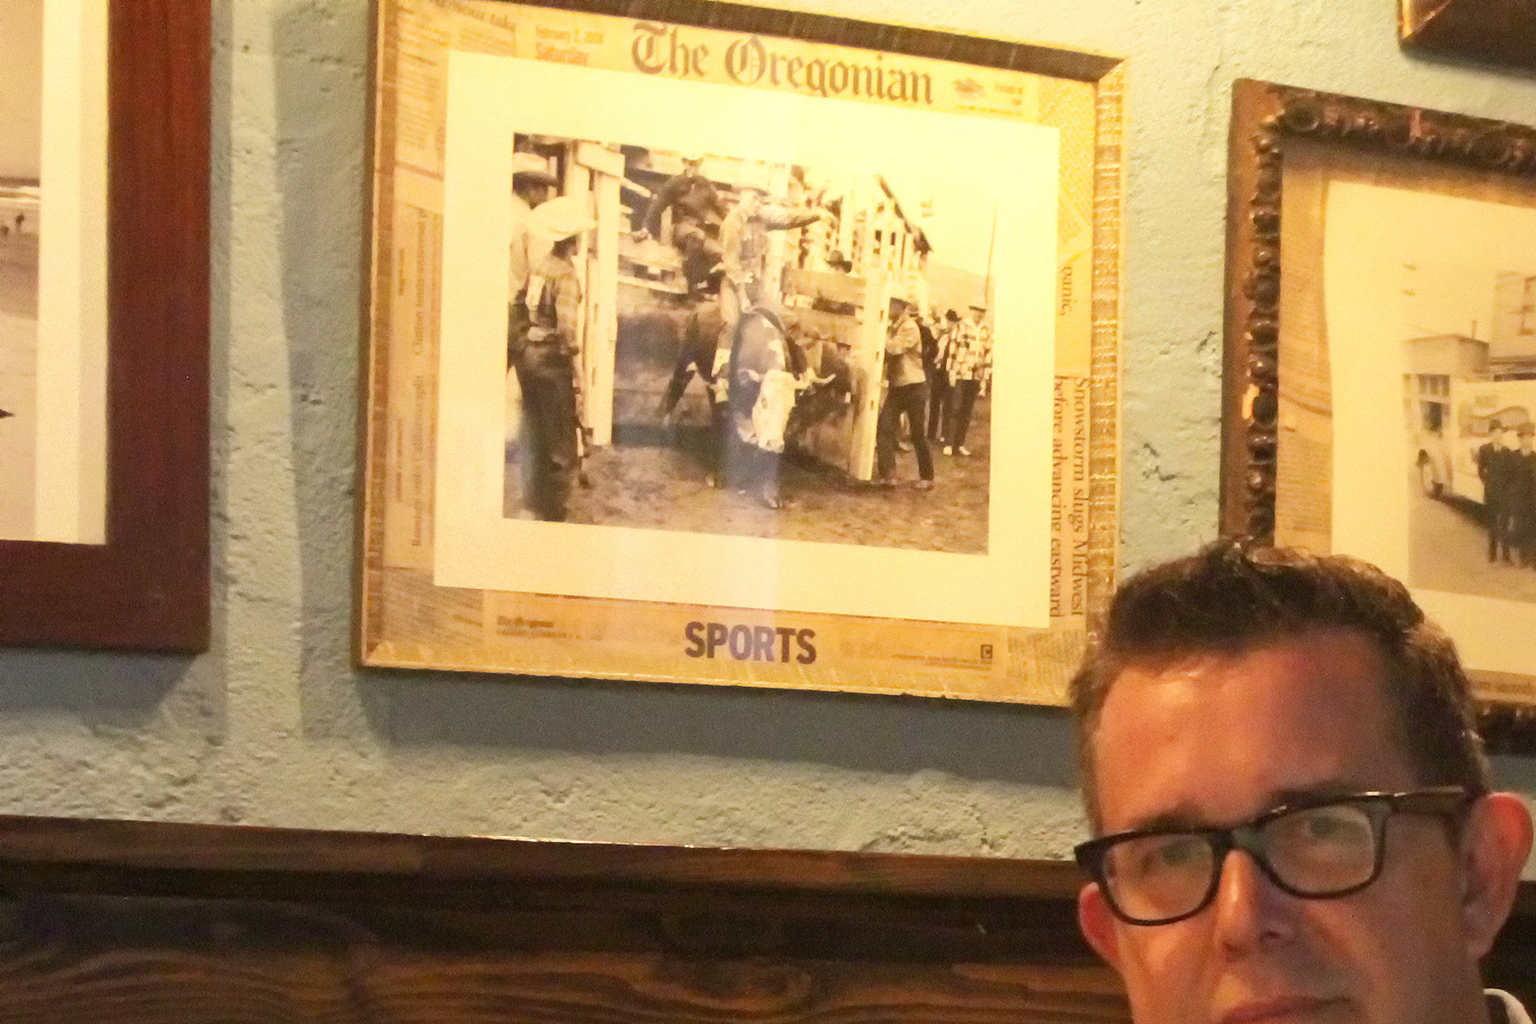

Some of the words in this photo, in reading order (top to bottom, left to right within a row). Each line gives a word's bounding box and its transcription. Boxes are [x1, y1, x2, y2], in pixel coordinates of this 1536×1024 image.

[631, 22, 710, 79] The
[724, 34, 934, 105] Oregonian
[1053, 376, 1071, 433] before
[1072, 377, 1090, 482] Snowstorm
[1052, 438, 1067, 533] advancing
[1067, 488, 1089, 533] slugs
[1050, 537, 1066, 617] eastward
[1071, 540, 1088, 616] Midwest
[684, 621, 817, 664] SPORTS
